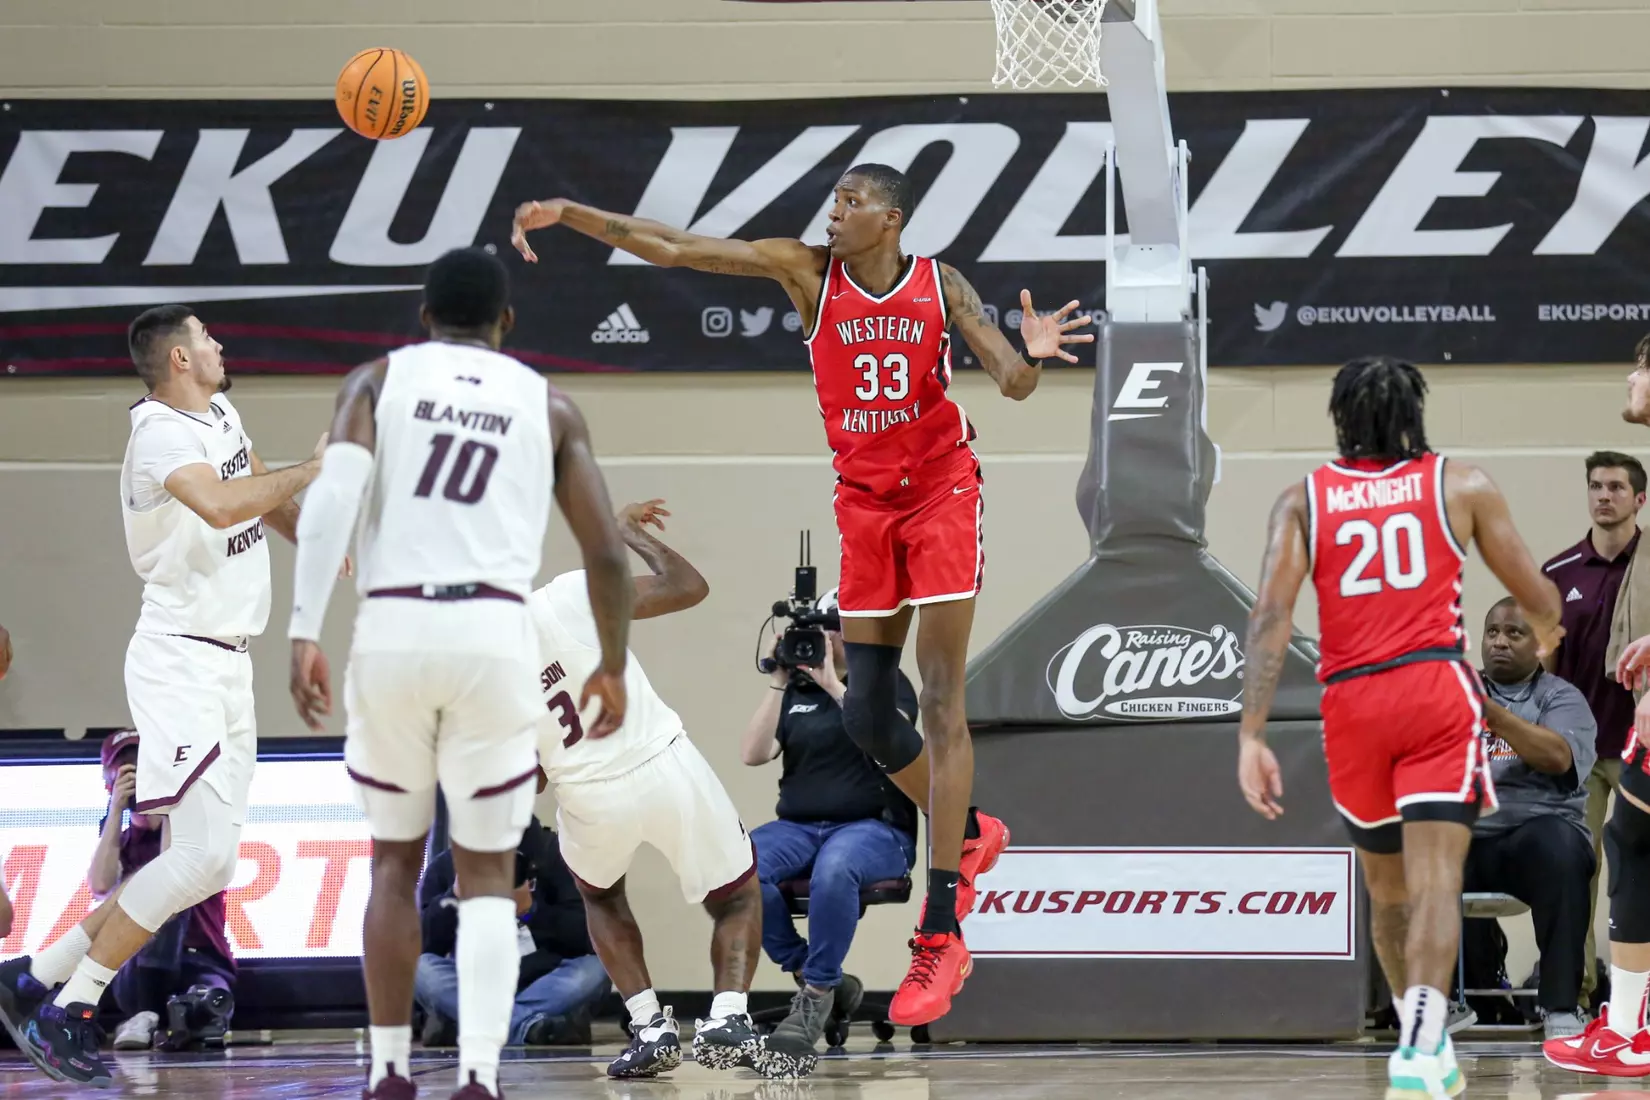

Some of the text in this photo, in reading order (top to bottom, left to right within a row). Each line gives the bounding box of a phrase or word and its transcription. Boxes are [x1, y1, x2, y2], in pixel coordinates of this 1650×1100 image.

[389, 79, 416, 135] Wilson
[0, 115, 1650, 266] EKU VOLLEY
[590, 329, 651, 344] adidas
[835, 316, 926, 346] WESTERN
[1296, 305, 1497, 326] @EKUVOLLEYBALL
[853, 352, 910, 402] 33
[1112, 361, 1185, 409] E
[413, 399, 514, 437] BLANTON
[413, 432, 500, 506] 10
[1325, 472, 1424, 514] McKNIGHT
[1334, 511, 1428, 599] 20
[1125, 629, 1192, 649] Raising
[1055, 624, 1246, 715] Cane's
[546, 689, 584, 749] 3
[1120, 700, 1229, 713] CHICKEN FINGERS
[173, 744, 192, 763] E
[970, 889, 1338, 915] KUSPORTS.COM
